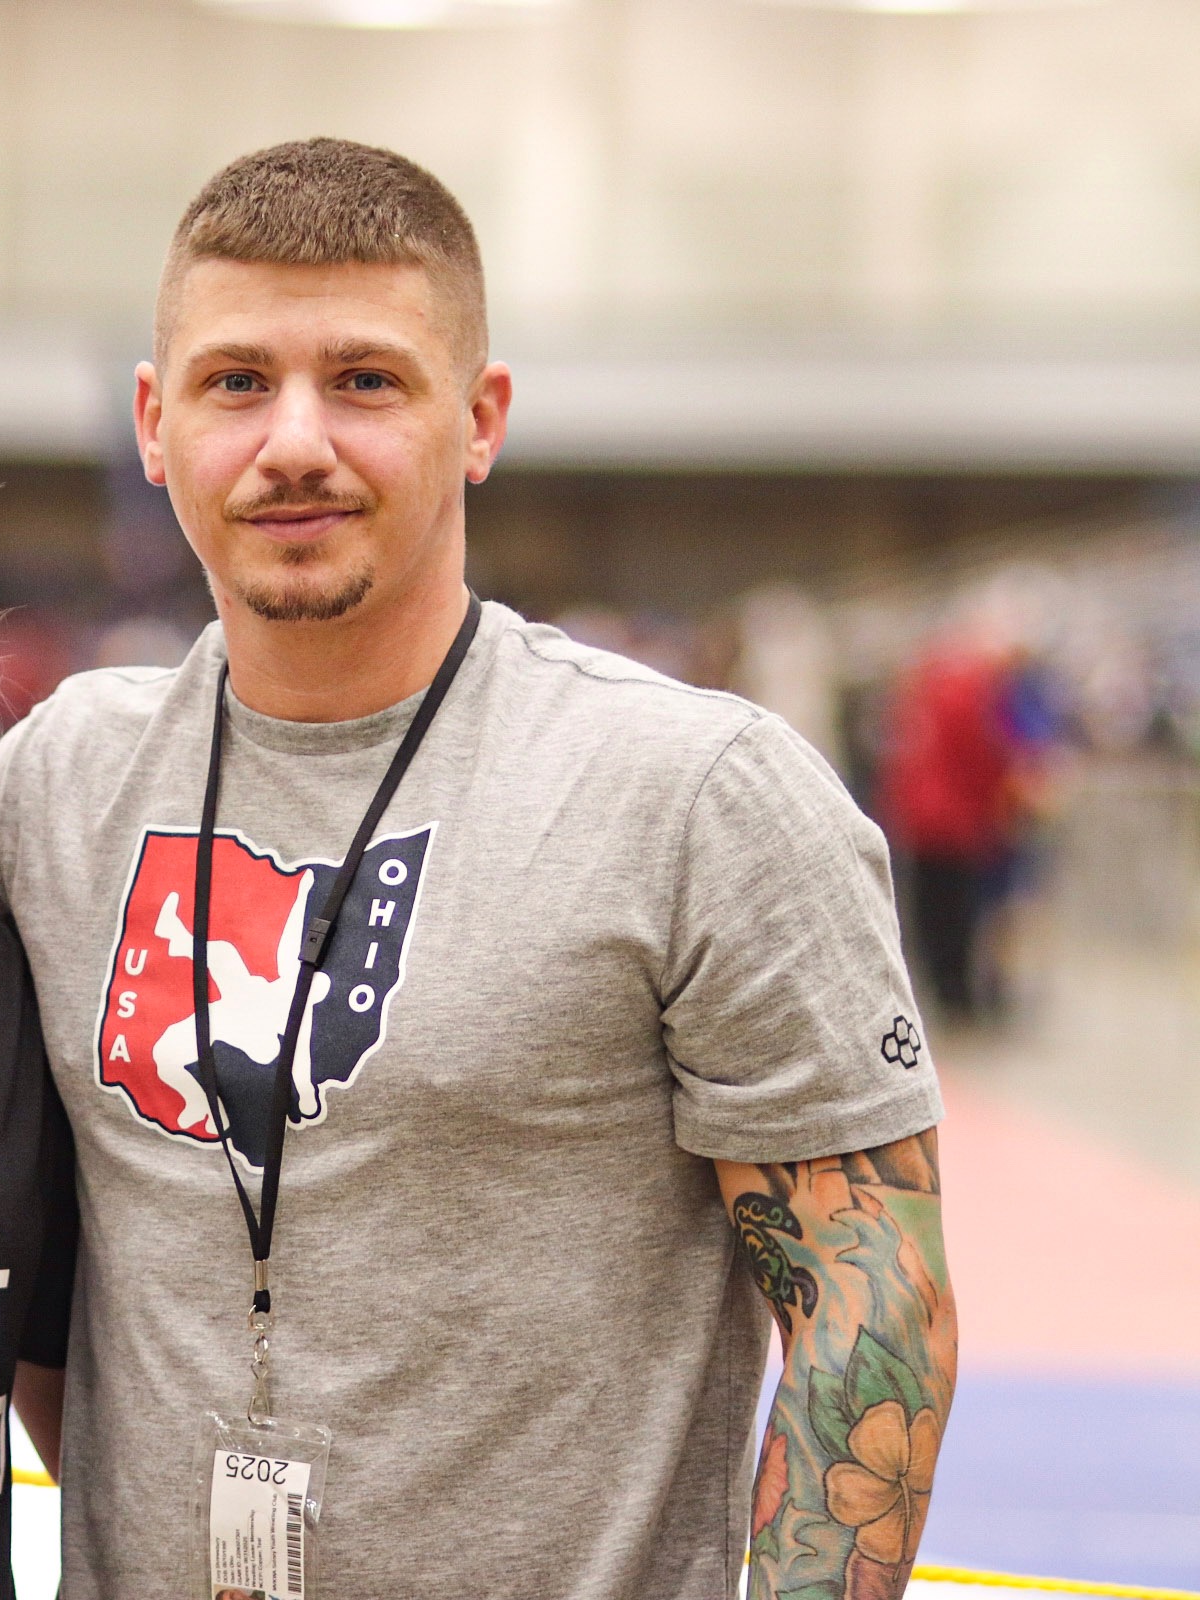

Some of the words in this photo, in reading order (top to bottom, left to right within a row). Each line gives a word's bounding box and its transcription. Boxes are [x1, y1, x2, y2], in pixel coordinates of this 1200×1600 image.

[348, 858, 408, 1013] OHIO
[109, 948, 147, 1063] USA
[226, 1454, 289, 1485] 2025
